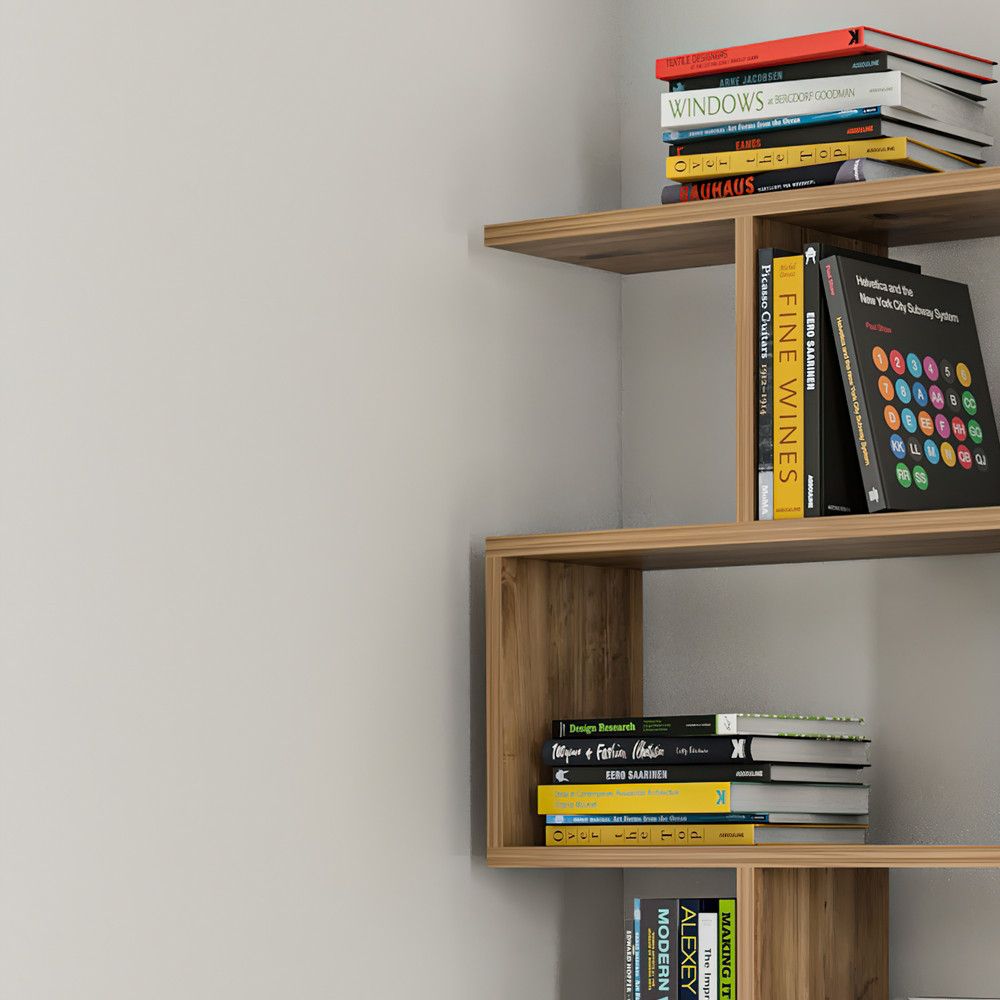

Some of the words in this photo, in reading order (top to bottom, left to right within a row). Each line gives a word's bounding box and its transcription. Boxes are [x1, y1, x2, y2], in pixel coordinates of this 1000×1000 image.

[666, 53, 691, 67] TEXTILE
[692, 50, 728, 64] DESIGNERS
[742, 71, 784, 85] JACOBSEN
[668, 90, 764, 118] WINDOWS
[814, 88, 856, 100] GOODMAN
[735, 138, 762, 150] EAMES
[679, 176, 756, 203] BAUHAUS
[761, 264, 772, 309] Picasso
[855, 275, 888, 292] Helvetica
[888, 284, 902, 295] and
[902, 285, 914, 298] the
[859, 292, 876, 306] New
[876, 296, 893, 310] York
[893, 299, 907, 314] City
[907, 302, 935, 321] Subway
[934, 308, 960, 323] System
[760, 311, 772, 359] Guitars
[779, 293, 797, 363] FINE
[806, 312, 816, 338] EERO
[806, 340, 816, 391] SAARINEN
[882, 382, 889, 393] 7
[917, 388, 925, 400] A
[949, 394, 957, 406] B
[779, 378, 797, 483] WINES
[905, 415, 913, 426] E
[953, 422, 966, 435] HH
[761, 485, 769, 515] MoMA
[569, 722, 597, 735] Design
[598, 721, 636, 733] Research
[605, 770, 626, 781] EERO
[628, 769, 668, 780] SAARINEN
[657, 908, 670, 991] MODERN
[680, 905, 697, 995] ALEXEY
[704, 948, 712, 968] The
[721, 912, 732, 978] MAKING
[721, 983, 732, 1000] IT
